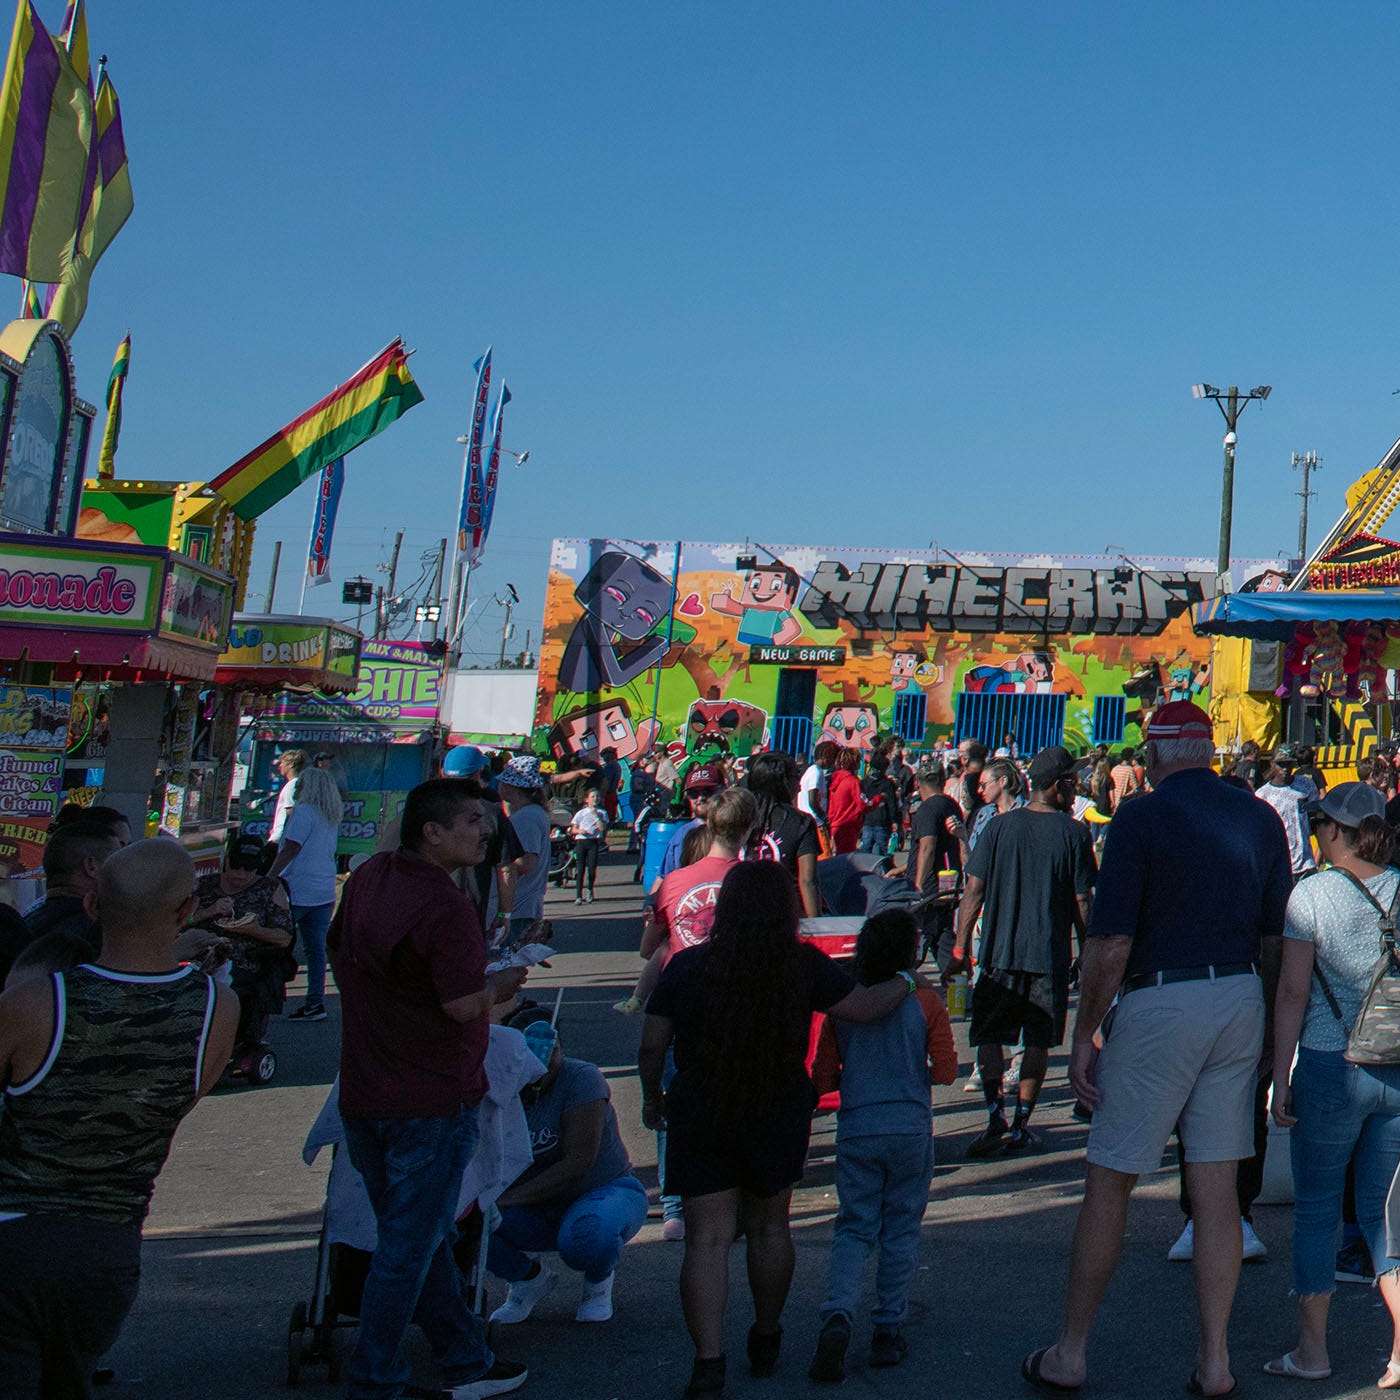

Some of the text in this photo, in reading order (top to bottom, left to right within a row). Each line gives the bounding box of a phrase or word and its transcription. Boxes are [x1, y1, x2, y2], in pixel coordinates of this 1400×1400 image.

[800, 561, 1217, 634] MINECRAFT
[365, 642, 389, 656] MIX
[760, 648, 836, 661] NEW GAME
[345, 667, 439, 704] SHIE
[296, 703, 401, 718] SOUVENIR CUPS
[0, 755, 60, 775] Funnel
